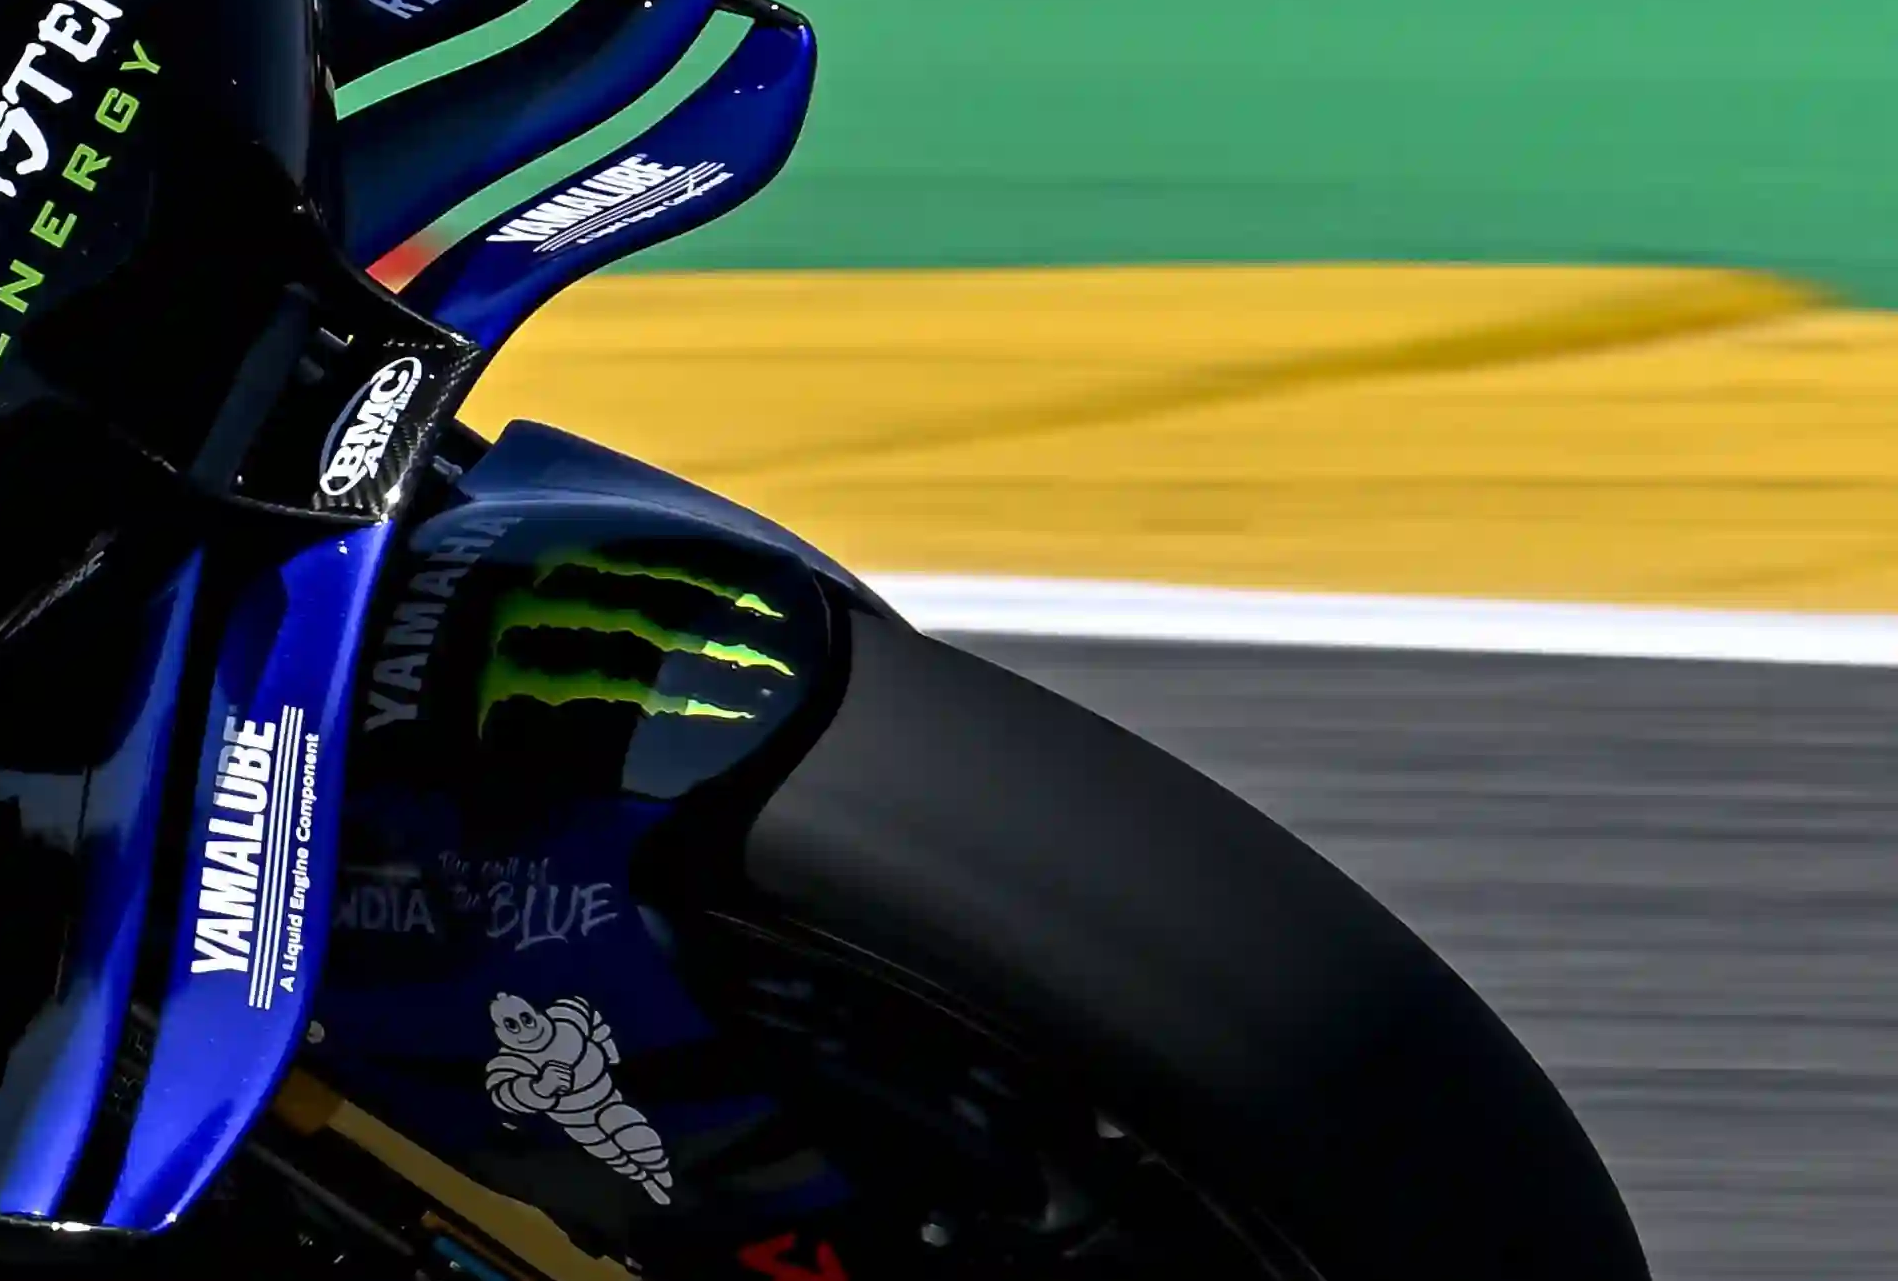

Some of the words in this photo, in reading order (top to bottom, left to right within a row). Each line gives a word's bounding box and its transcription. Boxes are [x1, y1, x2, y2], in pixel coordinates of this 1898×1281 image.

[485, 155, 687, 243] YAMALUBE
[326, 369, 410, 479] BMC
[362, 515, 525, 733] YAMAHA
[295, 731, 321, 843] Component
[190, 715, 277, 974] YAMALUBE
[288, 845, 312, 911] Engine
[280, 912, 304, 973] Liquid
[334, 887, 436, 936] NDIA
[484, 881, 620, 953] BLUE
[278, 975, 296, 994] A
